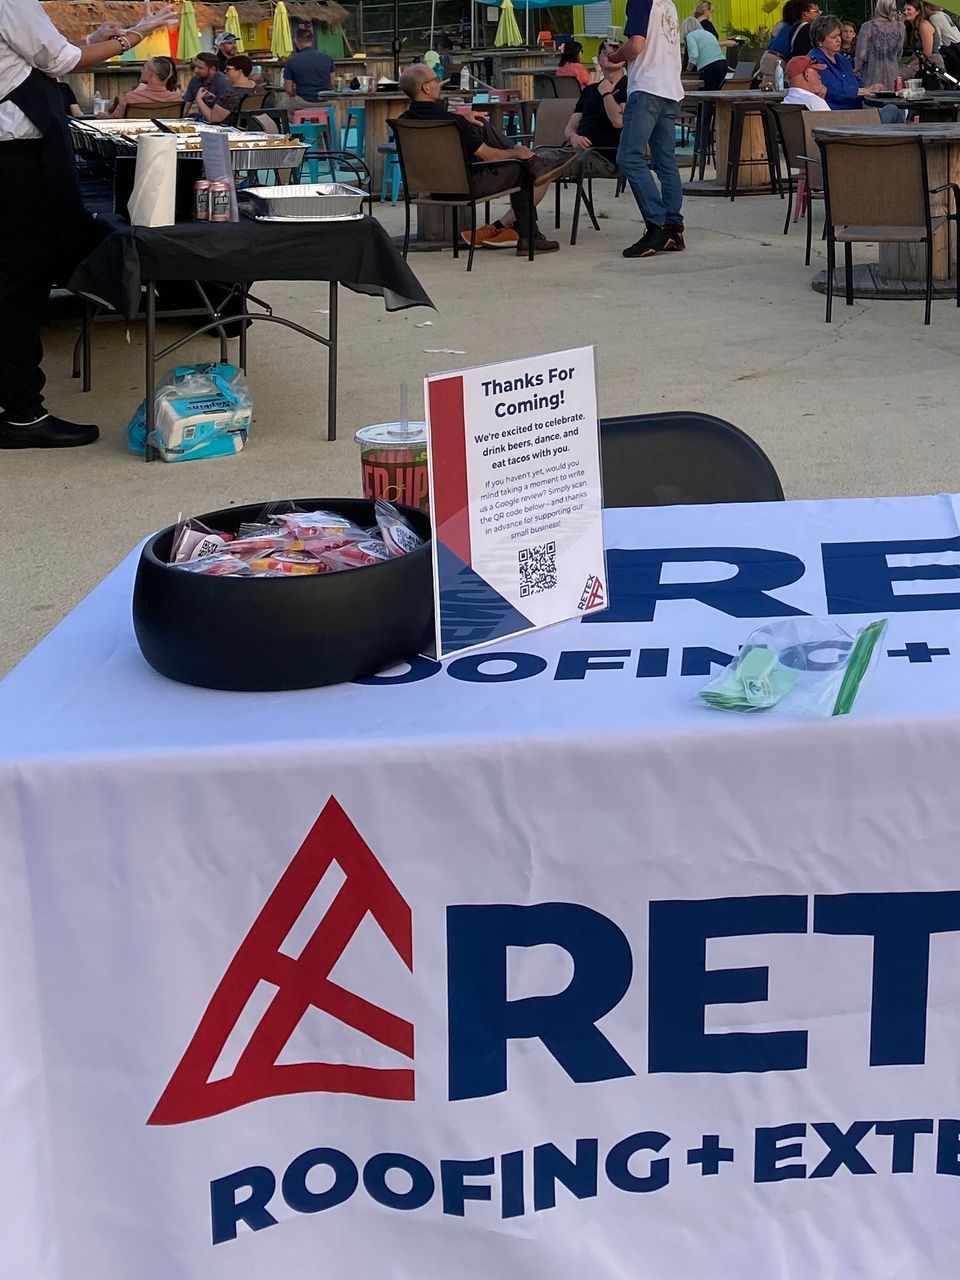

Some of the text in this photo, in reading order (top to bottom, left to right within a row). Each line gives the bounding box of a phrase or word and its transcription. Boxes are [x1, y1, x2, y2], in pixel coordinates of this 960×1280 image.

[481, 367, 575, 397] Thanks For
[494, 390, 565, 418] Coming!
[474, 432, 500, 444] We're
[501, 423, 533, 438] excited
[534, 422, 544, 431] to
[482, 427, 579, 457] drink beers, dance, and
[491, 445, 570, 469] eat tacos with you.
[480, 491, 499, 501] mind
[500, 485, 523, 496] taking
[529, 476, 559, 489] moment
[568, 469, 585, 479] write
[485, 481, 491, 489] If
[491, 480, 505, 489] you
[505, 472, 531, 484] haven't
[546, 463, 567, 473] would
[567, 460, 580, 469] you
[480, 505, 488, 513] us
[494, 497, 520, 509] Google
[520, 490, 547, 503] review?
[548, 483, 571, 496] Simply
[571, 480, 587, 490] scan
[480, 515, 493, 525] the
[493, 512, 504, 522] QR
[505, 507, 523, 518] code
[524, 503, 545, 513] below
[551, 497, 564, 506] and
[564, 491, 588, 502] thanks
[485, 503, 584, 535] in advance for supporting our
[510, 529, 529, 540] small
[577, 573, 595, 610] RETEX
[211, 1130, 673, 1246] ROOFING
